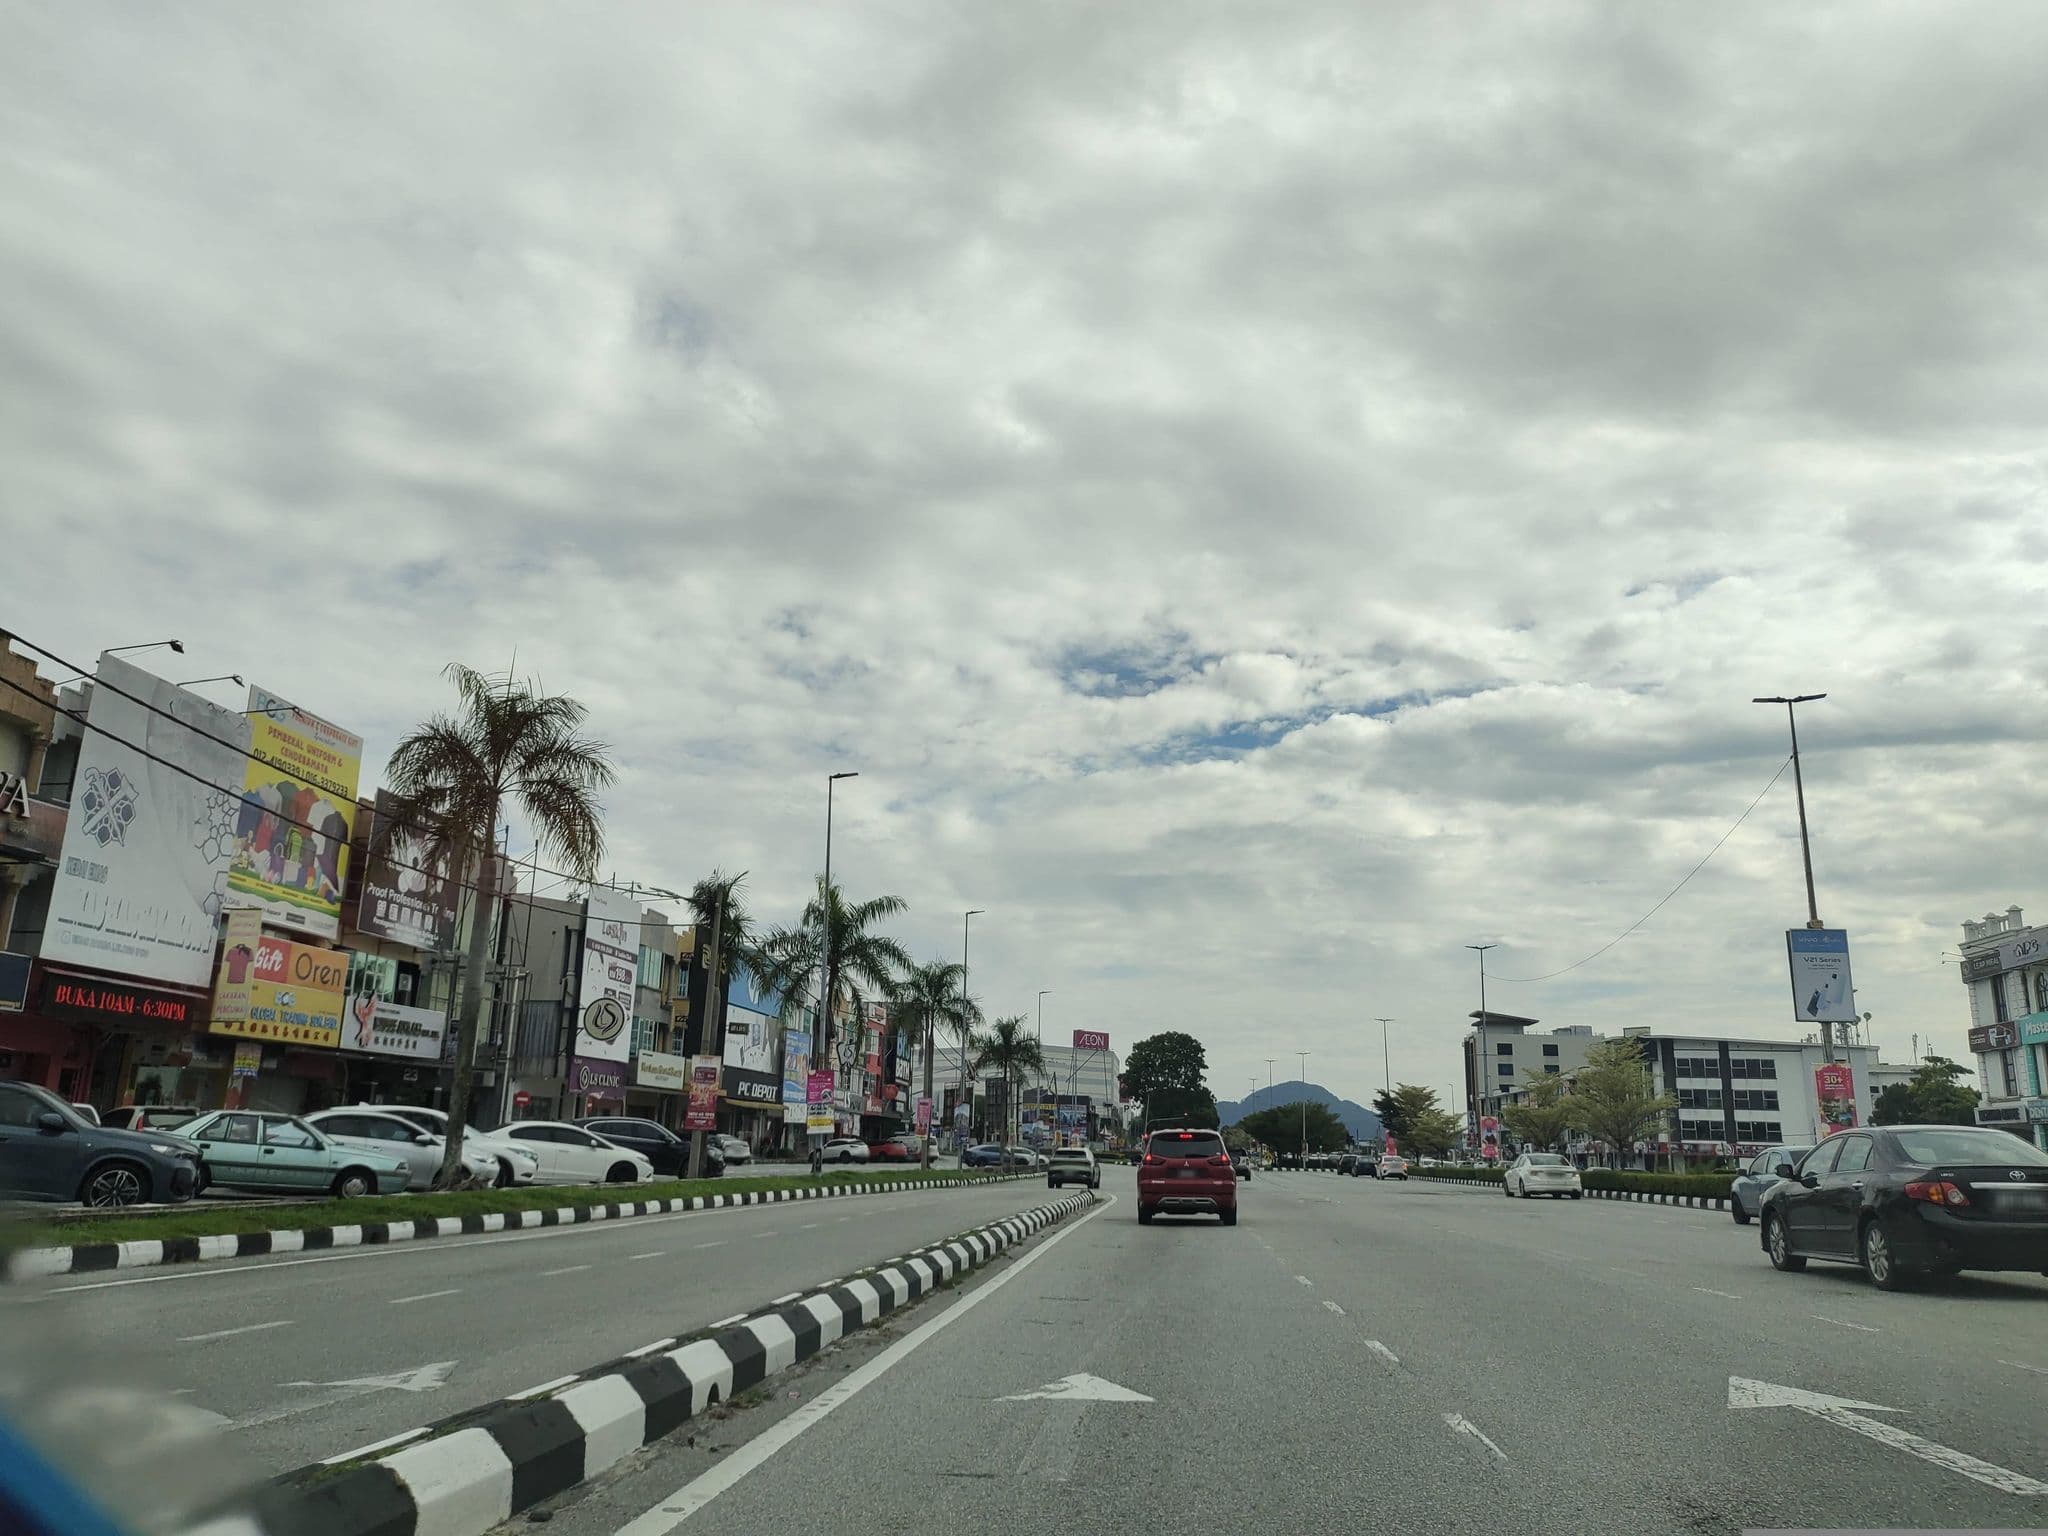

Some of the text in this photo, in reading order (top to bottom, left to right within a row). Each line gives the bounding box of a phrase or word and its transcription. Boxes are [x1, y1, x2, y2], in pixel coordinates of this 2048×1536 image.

[367, 882, 388, 899] Proof
[254, 946, 341, 987] Gift Oren
[55, 984, 97, 1009] BUKA
[98, 988, 136, 1015] 10AM
[143, 999, 187, 1021] 6:30PM
[599, 1073, 620, 1088] CLINIC
[1824, 1075, 1843, 1085] 30+
[737, 1081, 778, 1100] PC DEPOT
